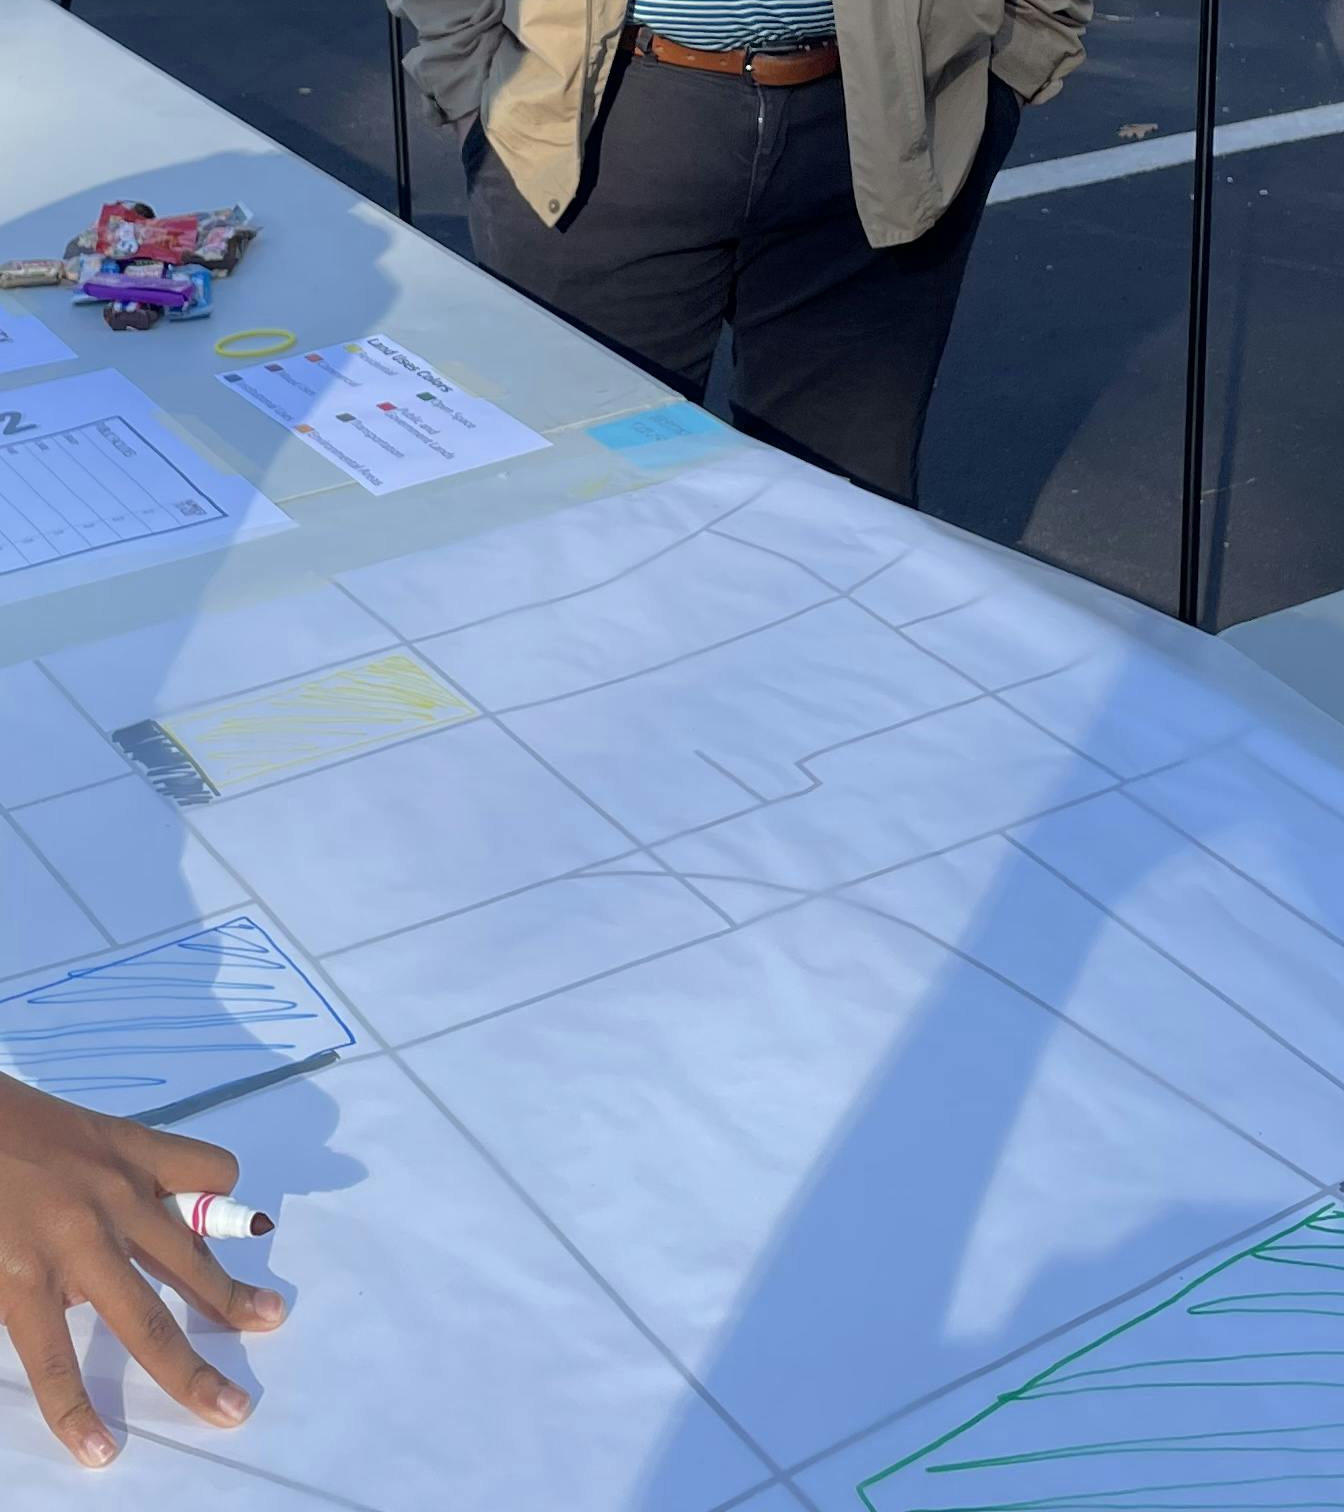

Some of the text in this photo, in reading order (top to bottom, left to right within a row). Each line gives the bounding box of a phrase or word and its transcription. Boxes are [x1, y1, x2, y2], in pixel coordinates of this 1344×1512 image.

[367, 338, 454, 392] Land Uses Colors
